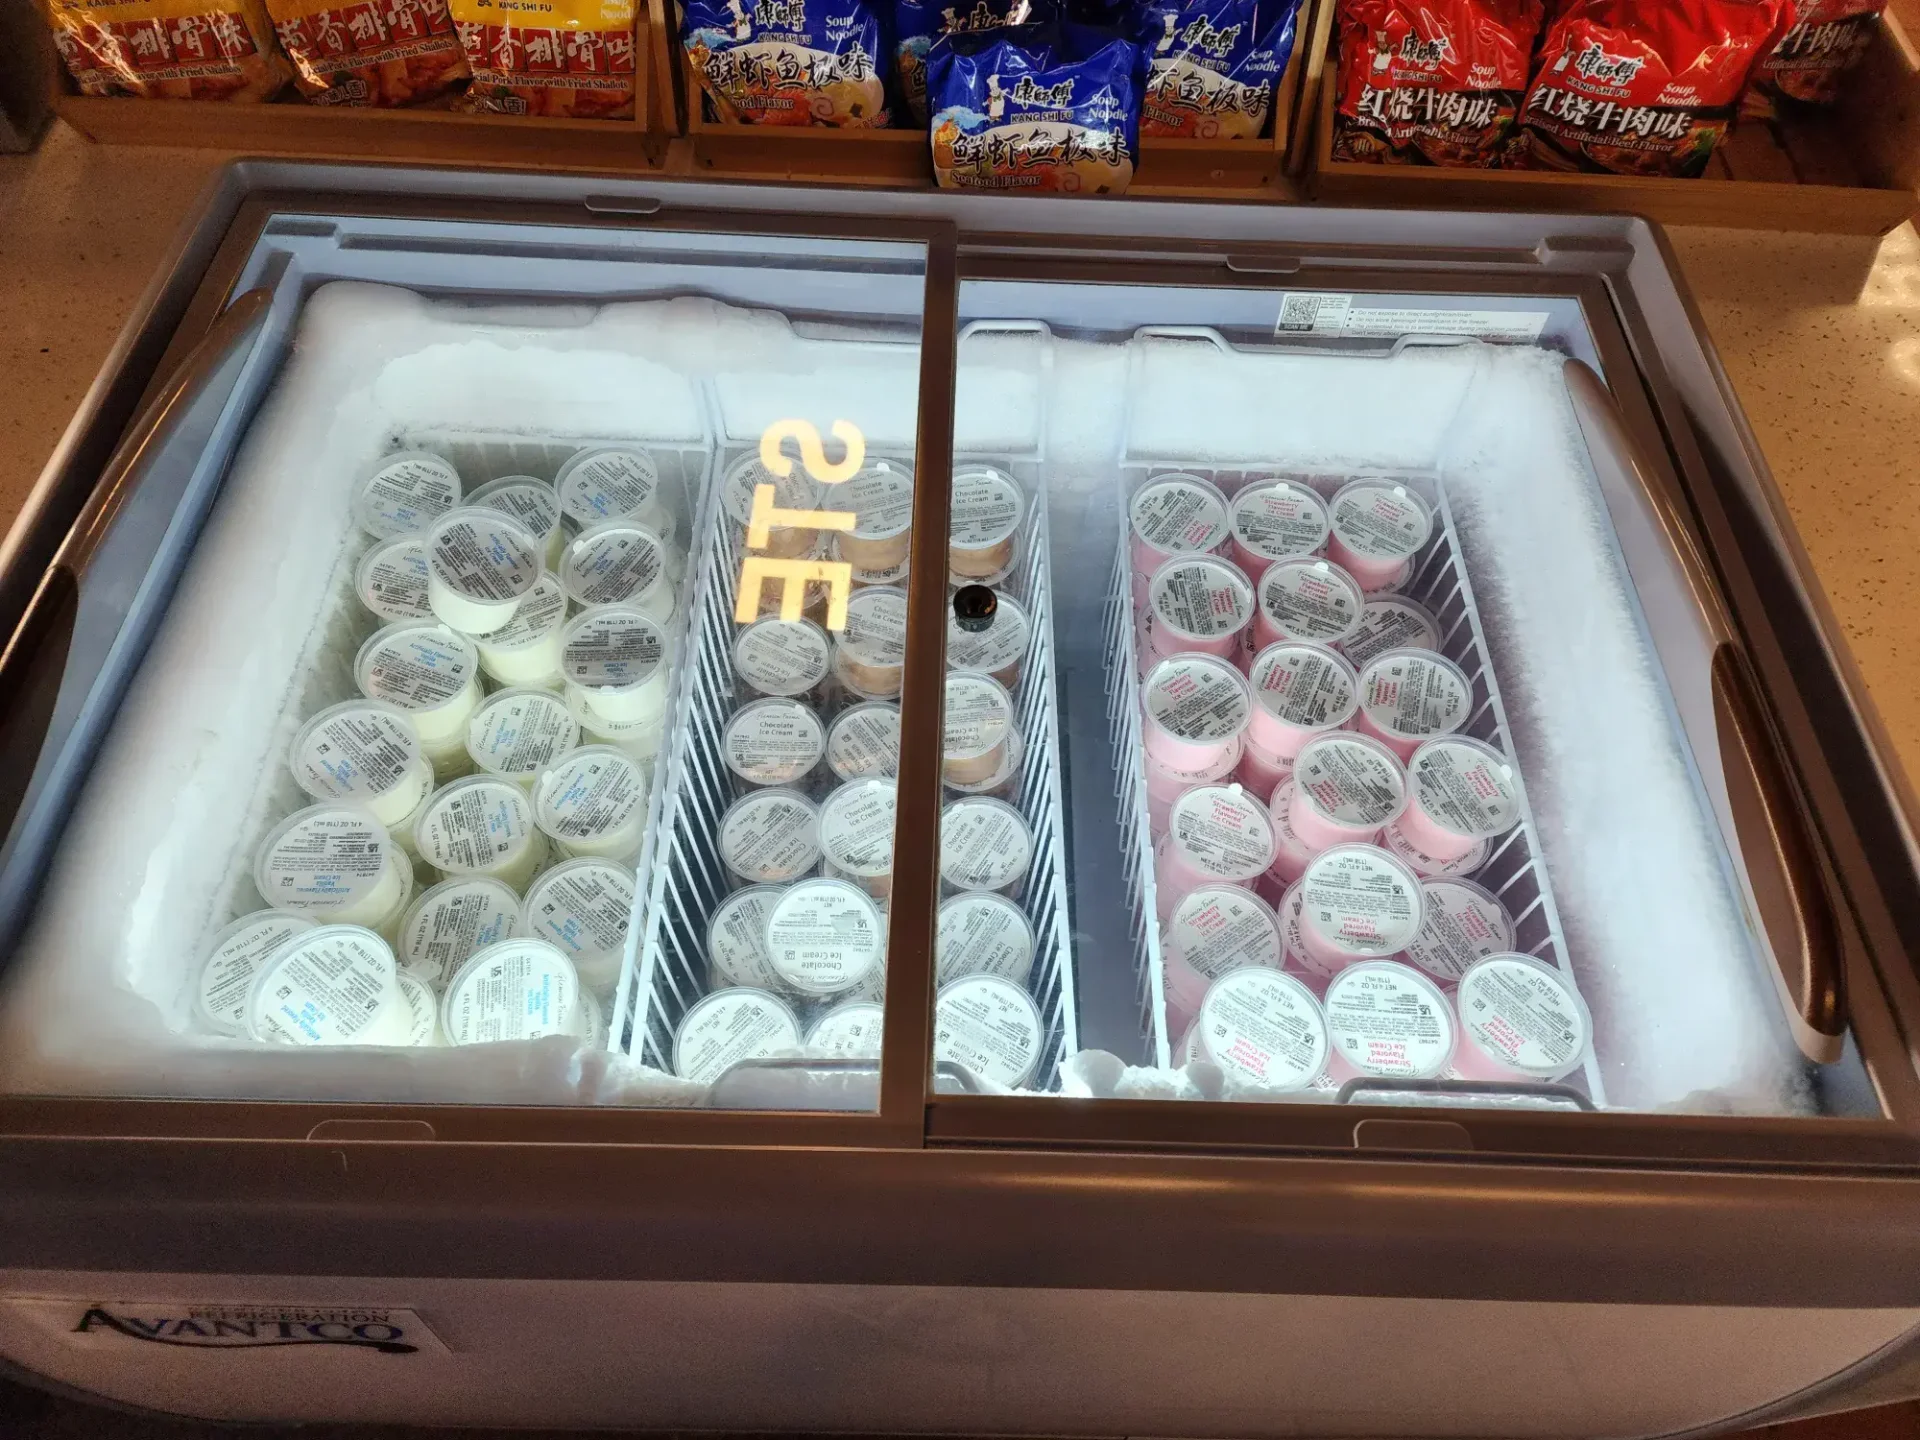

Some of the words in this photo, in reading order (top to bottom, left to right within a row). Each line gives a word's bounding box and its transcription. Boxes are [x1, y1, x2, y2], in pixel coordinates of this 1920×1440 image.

[540, 4, 552, 12] FU
[825, 14, 854, 28] Soup
[375, 52, 395, 63] with
[395, 47, 418, 59] Fried
[419, 40, 453, 53] Shallots
[1200, 57, 1216, 70] SHI
[1216, 60, 1231, 73] FU
[1470, 62, 1496, 77] Soup
[1575, 42, 1645, 86] 康師傅
[515, 76, 545, 87] Flavor
[549, 78, 567, 88] with
[568, 79, 592, 89] Fried
[594, 79, 629, 90] Shallots
[1465, 75, 1502, 89] Noodle
[1566, 77, 1593, 92] KANG
[1595, 86, 1615, 97] SHI
[1615, 88, 1632, 98] FU
[1663, 82, 1696, 97] Soup
[756, 95, 794, 110] Flavor
[1089, 93, 1119, 107] Soup
[1357, 84, 1498, 128] 红烧牛肉味
[1656, 93, 1702, 106] Noodle
[1010, 113, 1040, 123] KANG
[1042, 112, 1059, 121] SHI
[1060, 110, 1074, 120] FU
[1088, 107, 1129, 122] Noodle
[1145, 105, 1185, 127] Flavor
[1527, 83, 1692, 139] 红烧牛肉味
[1560, 128, 1608, 145] Artificial
[1612, 138, 1636, 150] Beef
[1637, 141, 1674, 152] Flavor
[951, 170, 998, 188] Seafood
[1000, 173, 1042, 188] Flavor
[759, 721, 793, 729] Chocolate
[842, 799, 879, 820] Chocolate
[848, 816, 860, 827] Ice
[859, 807, 883, 822] Cream
[944, 821, 969, 850] Chocolate
[952, 842, 963, 853] Ice
[959, 825, 976, 845] Cream
[769, 843, 791, 863] Cream
[775, 842, 807, 869] Chocolate
[1338, 927, 1382, 940] Strawberry
[1344, 922, 1375, 932] Flavored
[994, 940, 1005, 952] Ice
[1384, 983, 1397, 991] NET
[1527, 976, 1537, 987] OZ
[1535, 983, 1545, 993] FL
[1259, 986, 1270, 996] OZ
[1266, 983, 1280, 995] mL)
[1268, 991, 1278, 1001] FL
[1278, 990, 1292, 1002] (118
[1281, 999, 1295, 1010] NET
[1547, 994, 1561, 1007] NET
[1491, 1012, 1515, 1036] Cream
[1478, 1018, 1518, 1059] Strawberry
[1488, 1018, 1519, 1050] Flavored
[1512, 1032, 1526, 1046] Ice
[951, 1039, 977, 1058] Cream
[1233, 1036, 1259, 1055] Cream
[1366, 1040, 1392, 1050] Cream
[1393, 1043, 1405, 1052] Ice
[976, 1052, 990, 1065] Ice
[1232, 1044, 1265, 1067] Flavored
[1258, 1050, 1271, 1062] Ice
[1370, 1048, 1404, 1059] Flavored
[1224, 1047, 1267, 1076] Strawberry
[1366, 1055, 1410, 1067] Strawberry
[69, 1308, 405, 1342] AVANTCO
